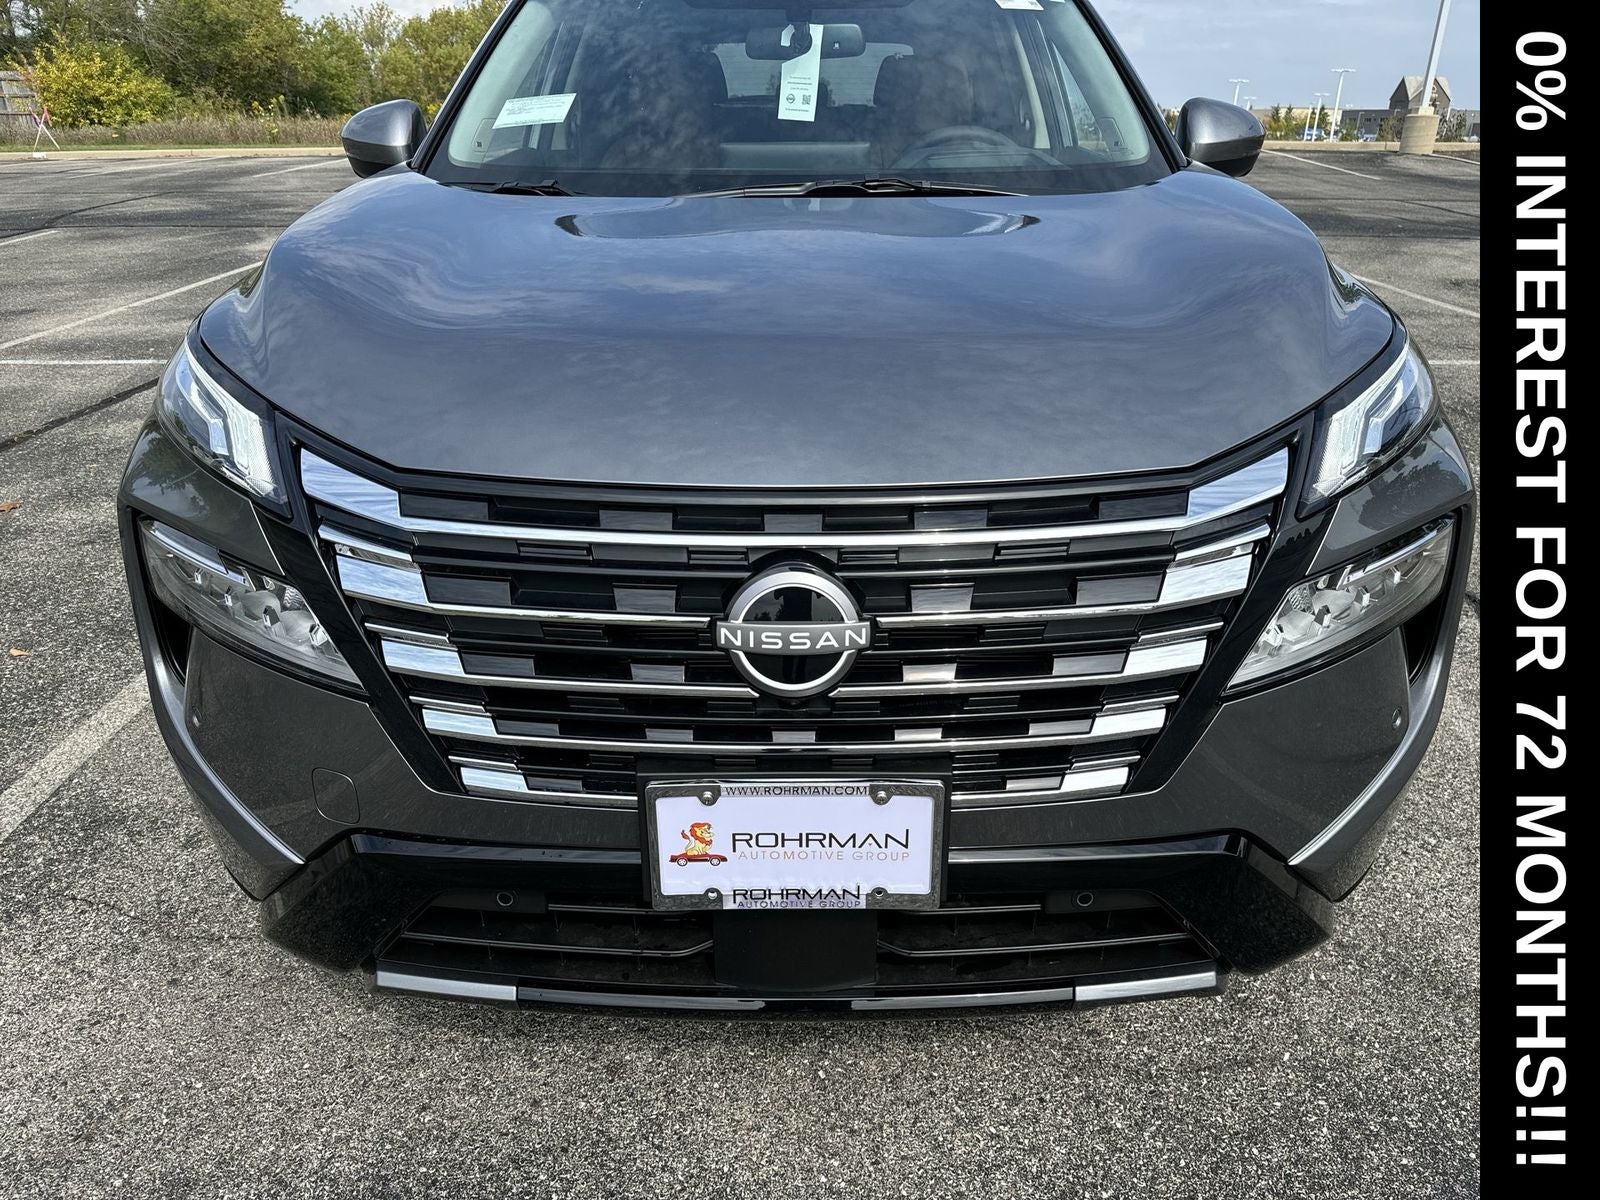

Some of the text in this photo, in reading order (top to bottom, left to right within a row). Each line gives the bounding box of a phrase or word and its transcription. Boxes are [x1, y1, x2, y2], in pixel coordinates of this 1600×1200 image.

[720, 627, 866, 650] NISSAN
[725, 785, 869, 796] WWW.ROHRMAN.COM
[732, 829, 910, 853] ROHRMAN
[737, 850, 910, 861] AUTOMOTIVE GROUP
[732, 885, 860, 904] ROHRMAN
[737, 900, 861, 909] AUTOMOTIVE GROUP
